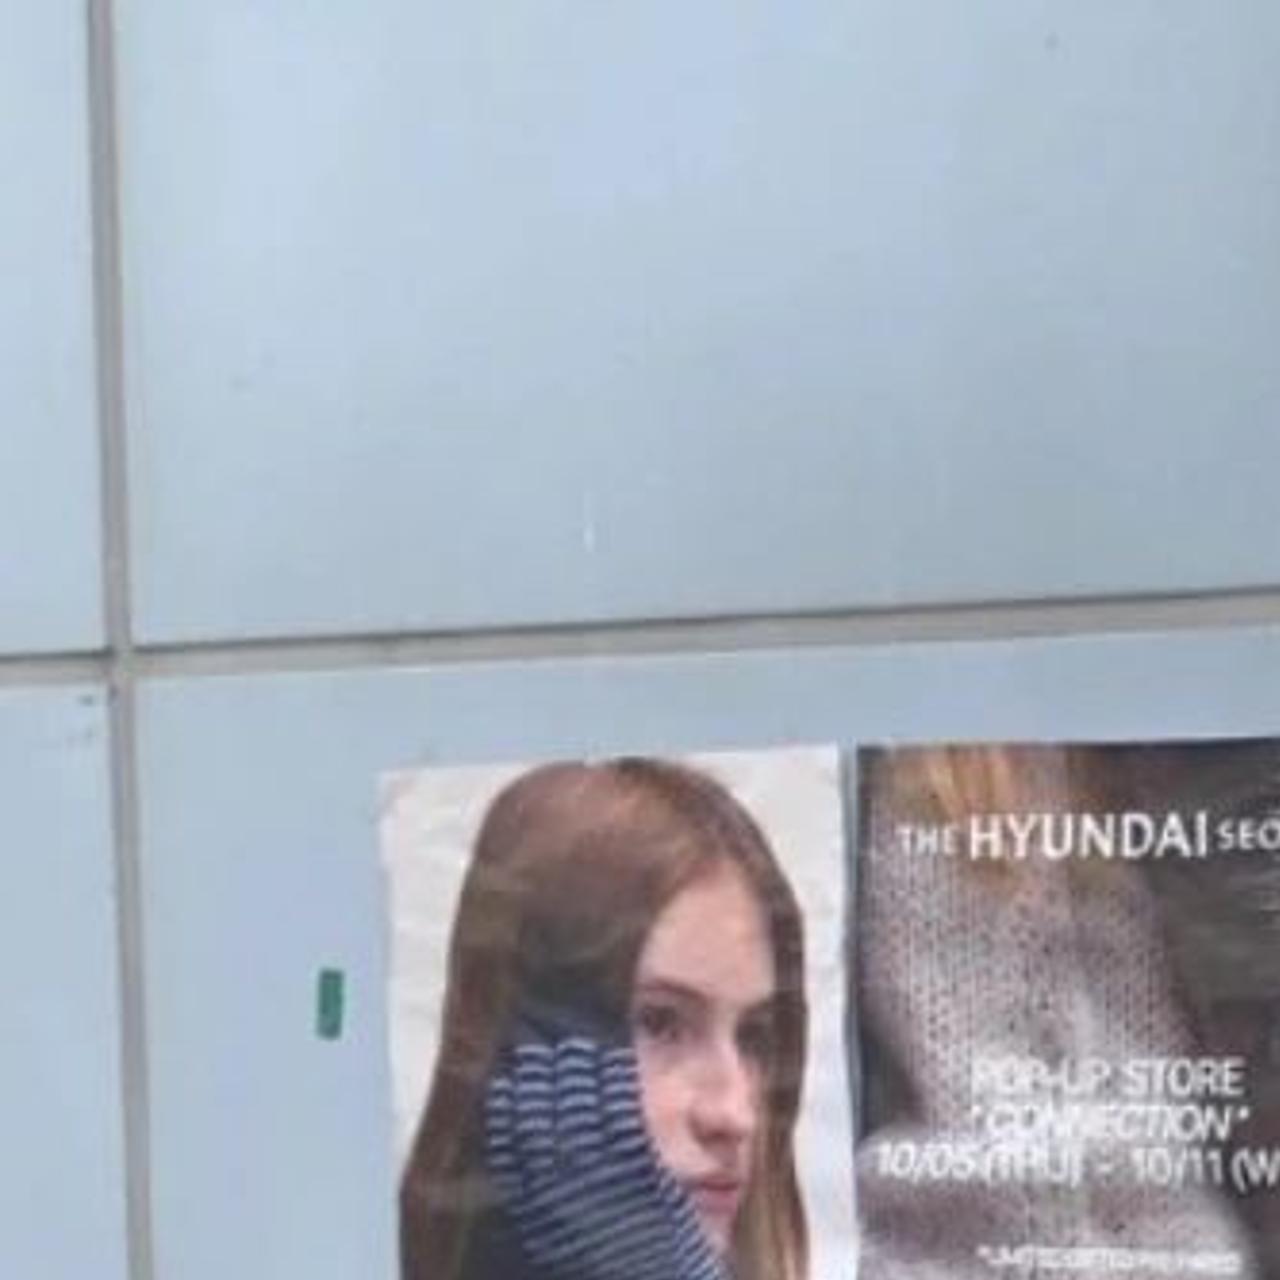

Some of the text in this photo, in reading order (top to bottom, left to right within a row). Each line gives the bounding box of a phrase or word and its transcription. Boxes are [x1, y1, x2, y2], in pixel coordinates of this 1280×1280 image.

[900, 825, 957, 855] THE
[969, 811, 1207, 860] HYUNDAI
[972, 1056, 1246, 1097] POP-UP STORE
